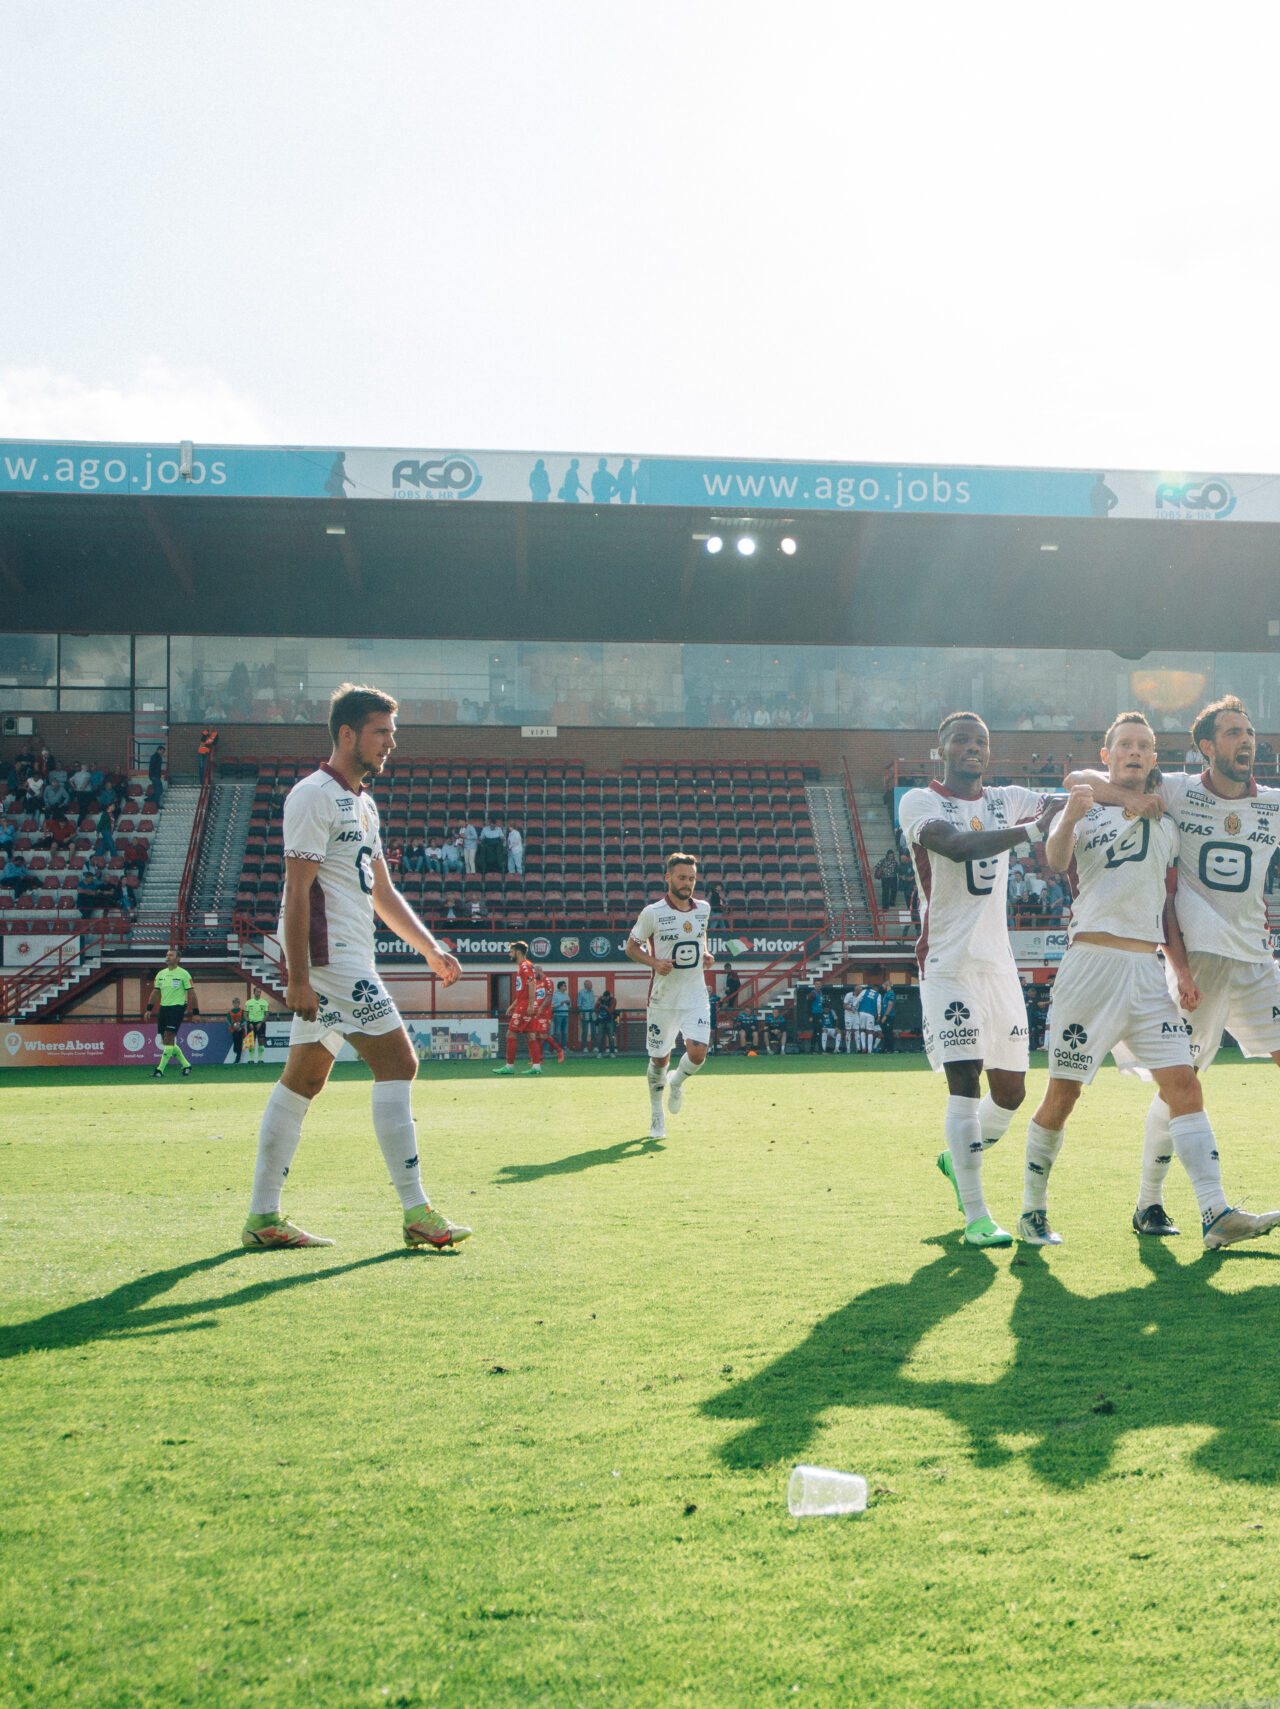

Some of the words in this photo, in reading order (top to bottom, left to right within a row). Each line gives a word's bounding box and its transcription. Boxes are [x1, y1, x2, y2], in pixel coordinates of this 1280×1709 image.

[392, 458, 475, 490] AGO
[393, 490, 422, 499] JOBS
[438, 491, 455, 500] HR
[703, 471, 971, 508] www.ago.jobs
[1179, 821, 1214, 836] AFAS
[335, 831, 363, 842] AFAS
[1084, 829, 1118, 852] AFAS
[1247, 831, 1276, 845] AFAS
[457, 938, 511, 953] Motors
[352, 998, 393, 1018] Golden
[361, 1007, 393, 1027] palace
[939, 1027, 980, 1040] Golden
[24, 1040, 105, 1051] WhereAbout
[943, 1037, 977, 1048] palace
[1054, 1048, 1093, 1065] Golden
[1058, 1059, 1088, 1071] palace
